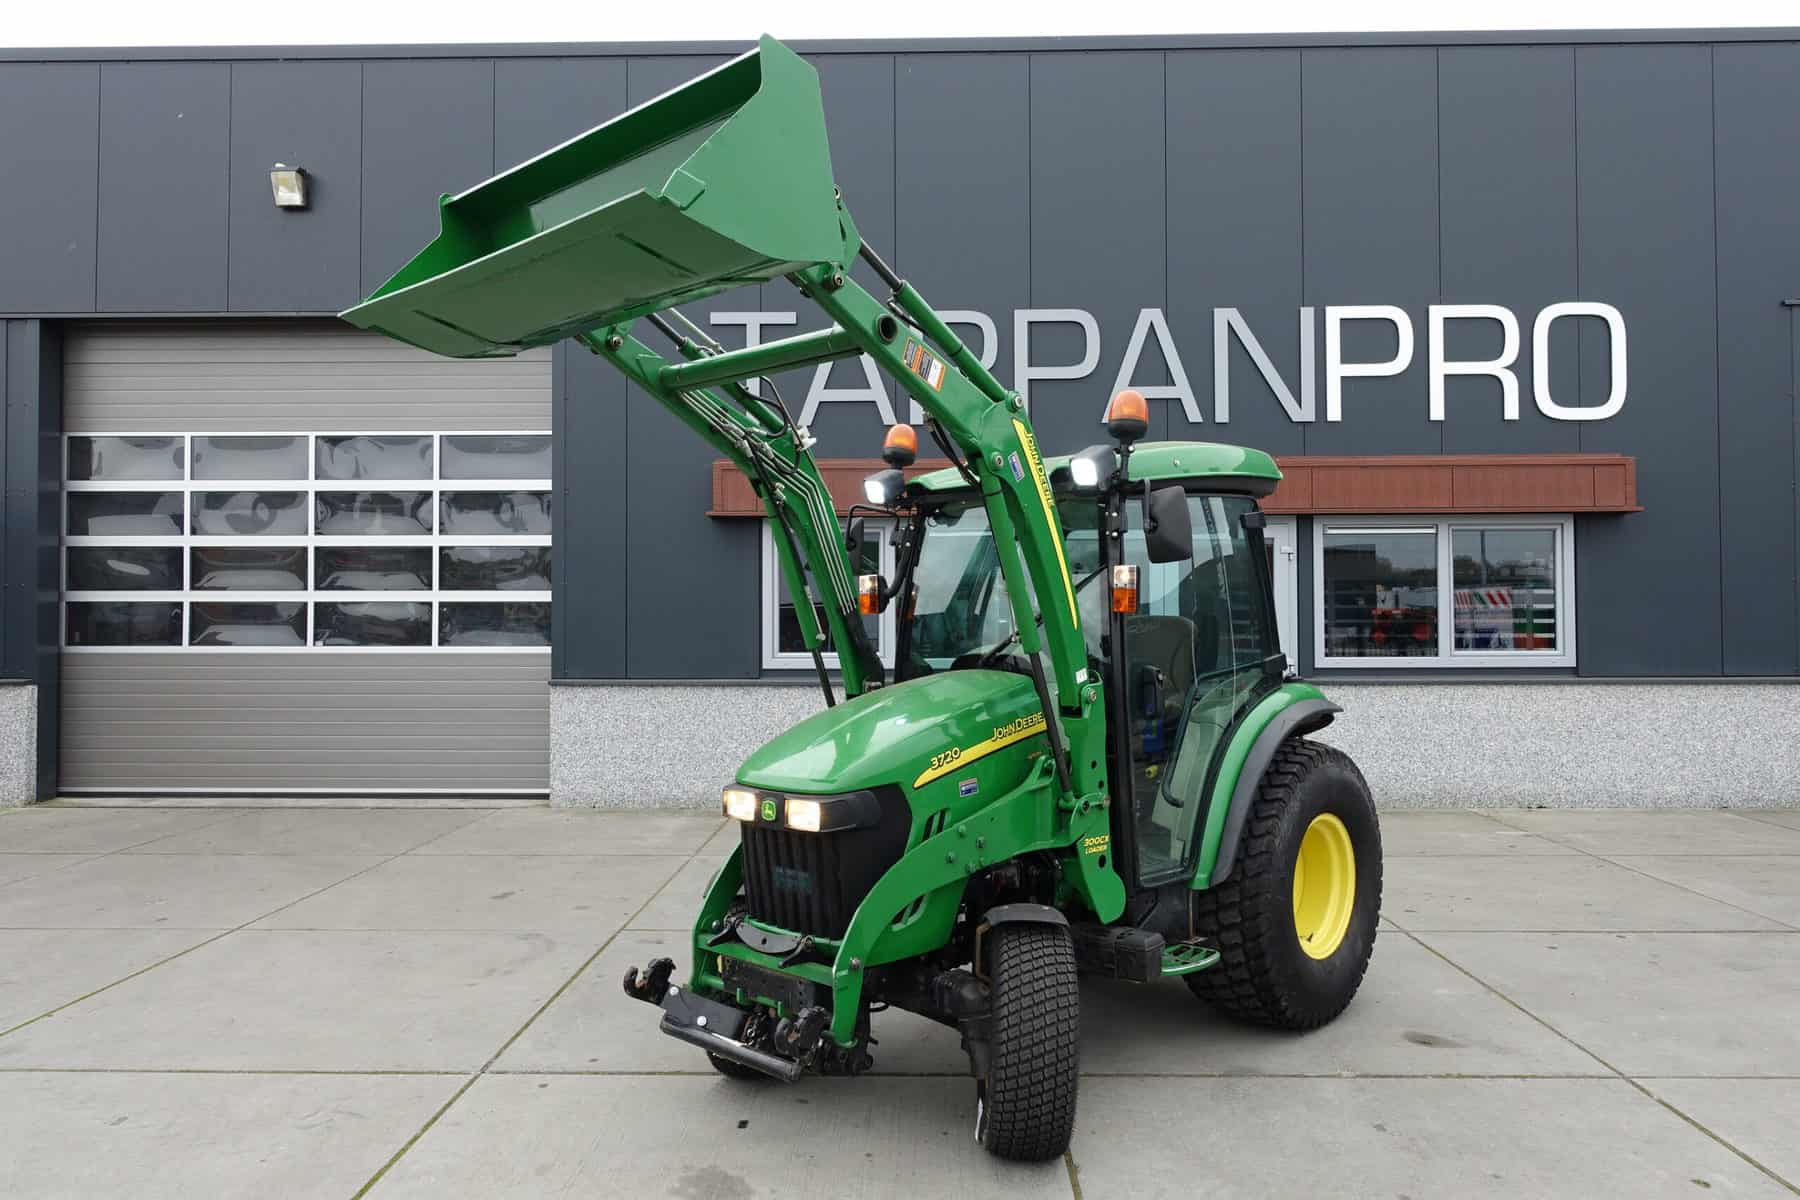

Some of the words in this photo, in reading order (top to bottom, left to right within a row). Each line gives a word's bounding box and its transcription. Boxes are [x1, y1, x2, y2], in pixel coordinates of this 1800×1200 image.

[991, 722, 1015, 742] JOHN
[1015, 711, 1044, 732] DEERE
[930, 747, 961, 770] 3720
